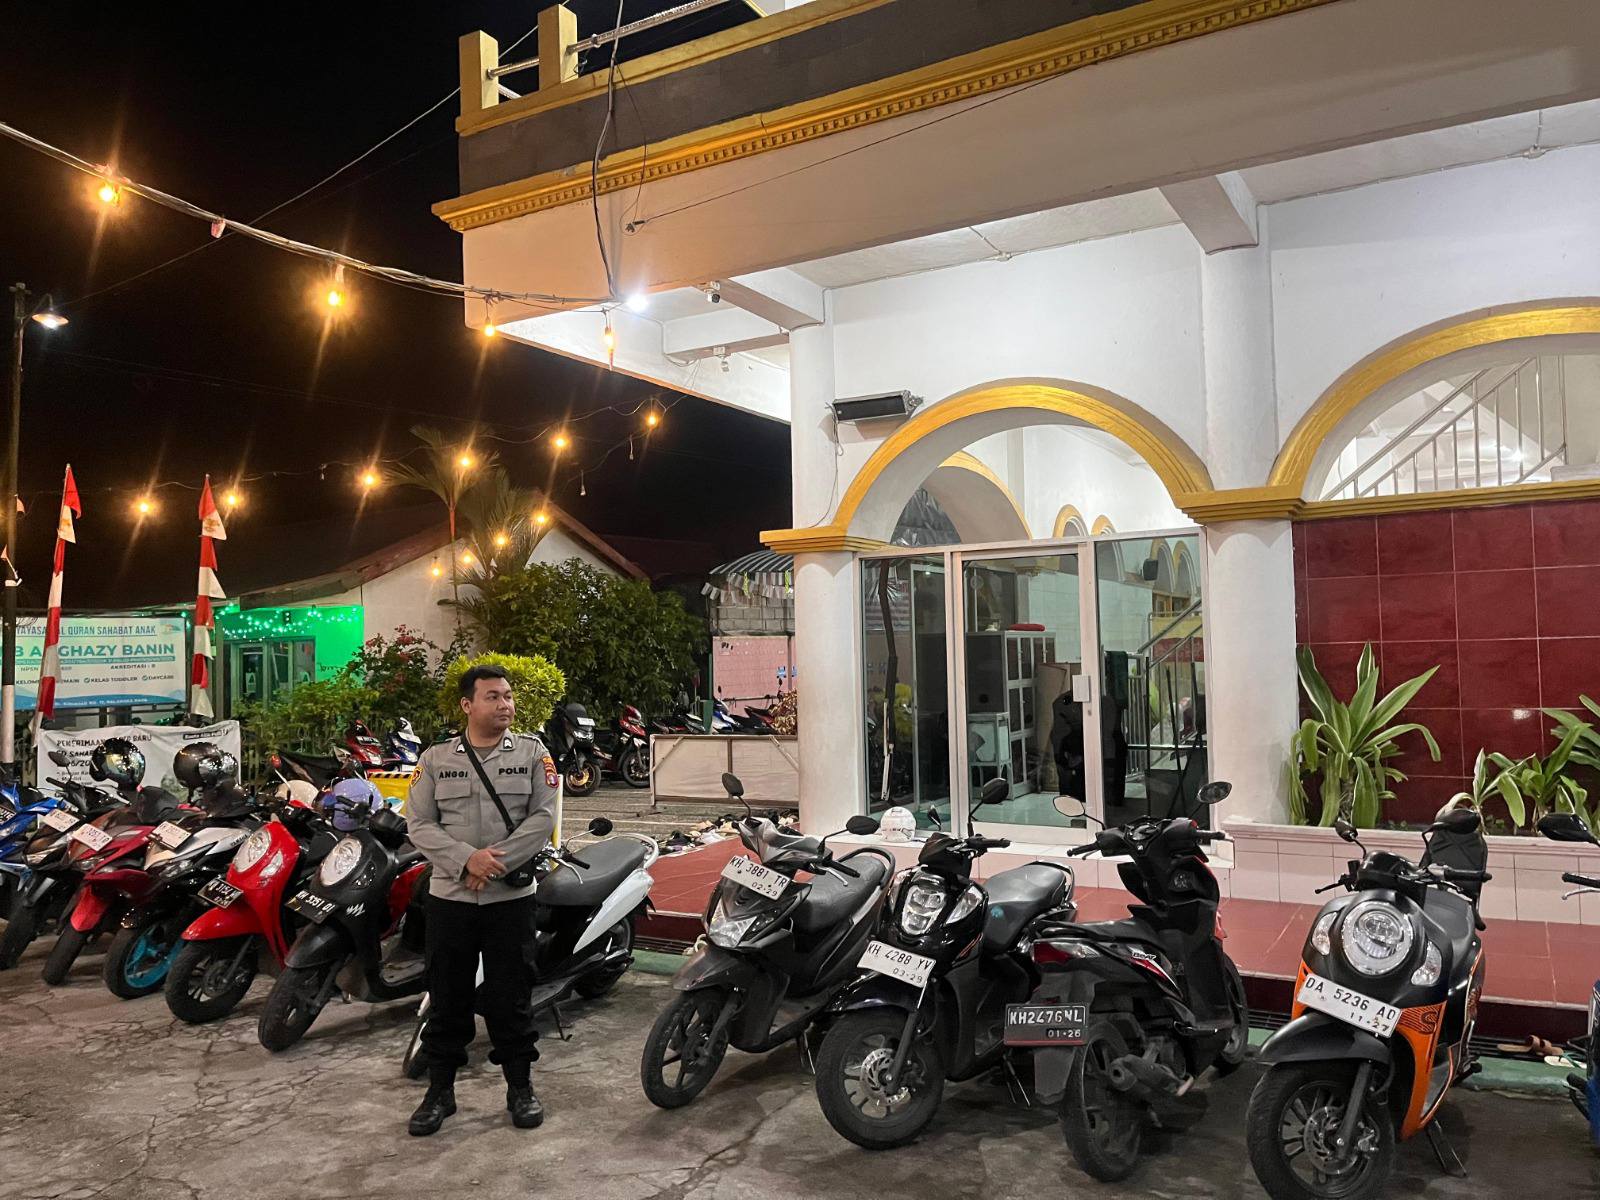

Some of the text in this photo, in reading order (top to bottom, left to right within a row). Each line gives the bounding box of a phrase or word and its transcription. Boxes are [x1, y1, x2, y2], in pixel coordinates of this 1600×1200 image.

[17, 626, 46, 634] YAYASA
[68, 626, 94, 634] QURAN
[97, 626, 133, 634] SAHABAT
[135, 625, 156, 634] ANAK
[57, 645, 117, 657] GHAZY
[122, 643, 174, 655] BANIN
[438, 770, 468, 779] ANGGI
[498, 766, 528, 776] POLRI
[730, 856, 788, 888] KH 3881 TR
[866, 943, 934, 971] KH 4288 YV
[1305, 977, 1325, 994] DA
[1333, 988, 1371, 1011] 5236
